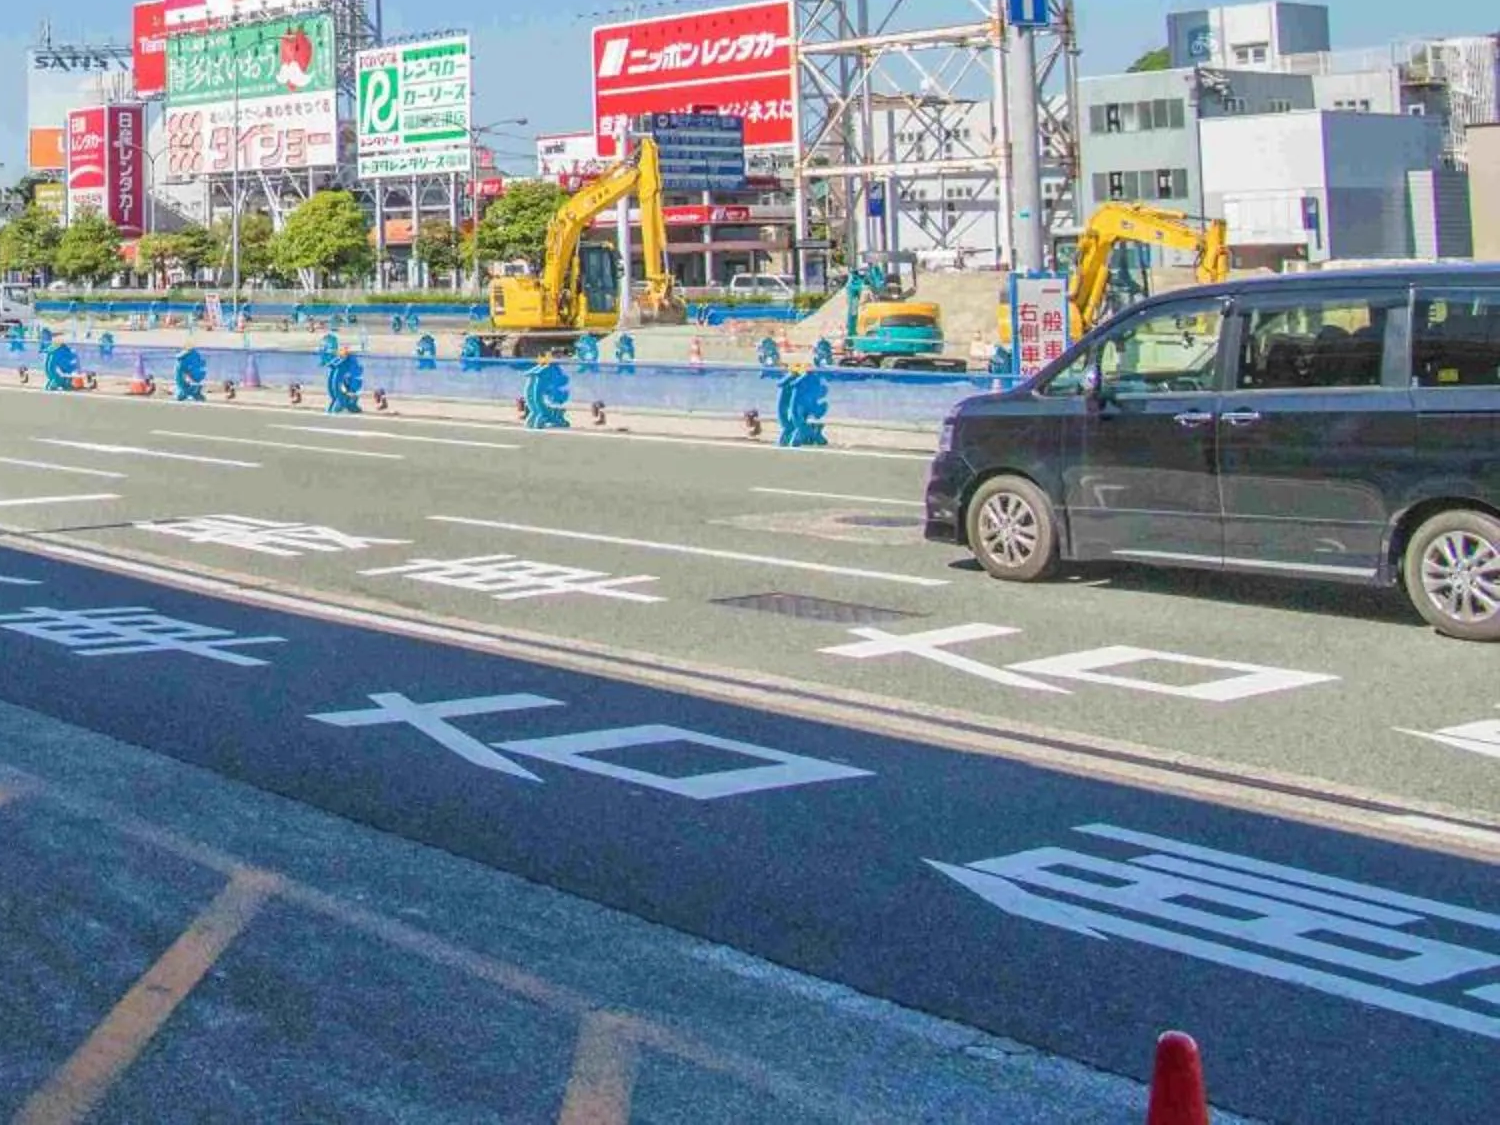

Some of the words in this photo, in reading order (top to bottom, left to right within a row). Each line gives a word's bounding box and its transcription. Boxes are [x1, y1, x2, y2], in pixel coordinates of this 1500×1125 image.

[404, 58, 467, 80] レンタカー
[627, 32, 799, 74] ニッポンレンタカー
[1041, 288, 1062, 360] 一般車
